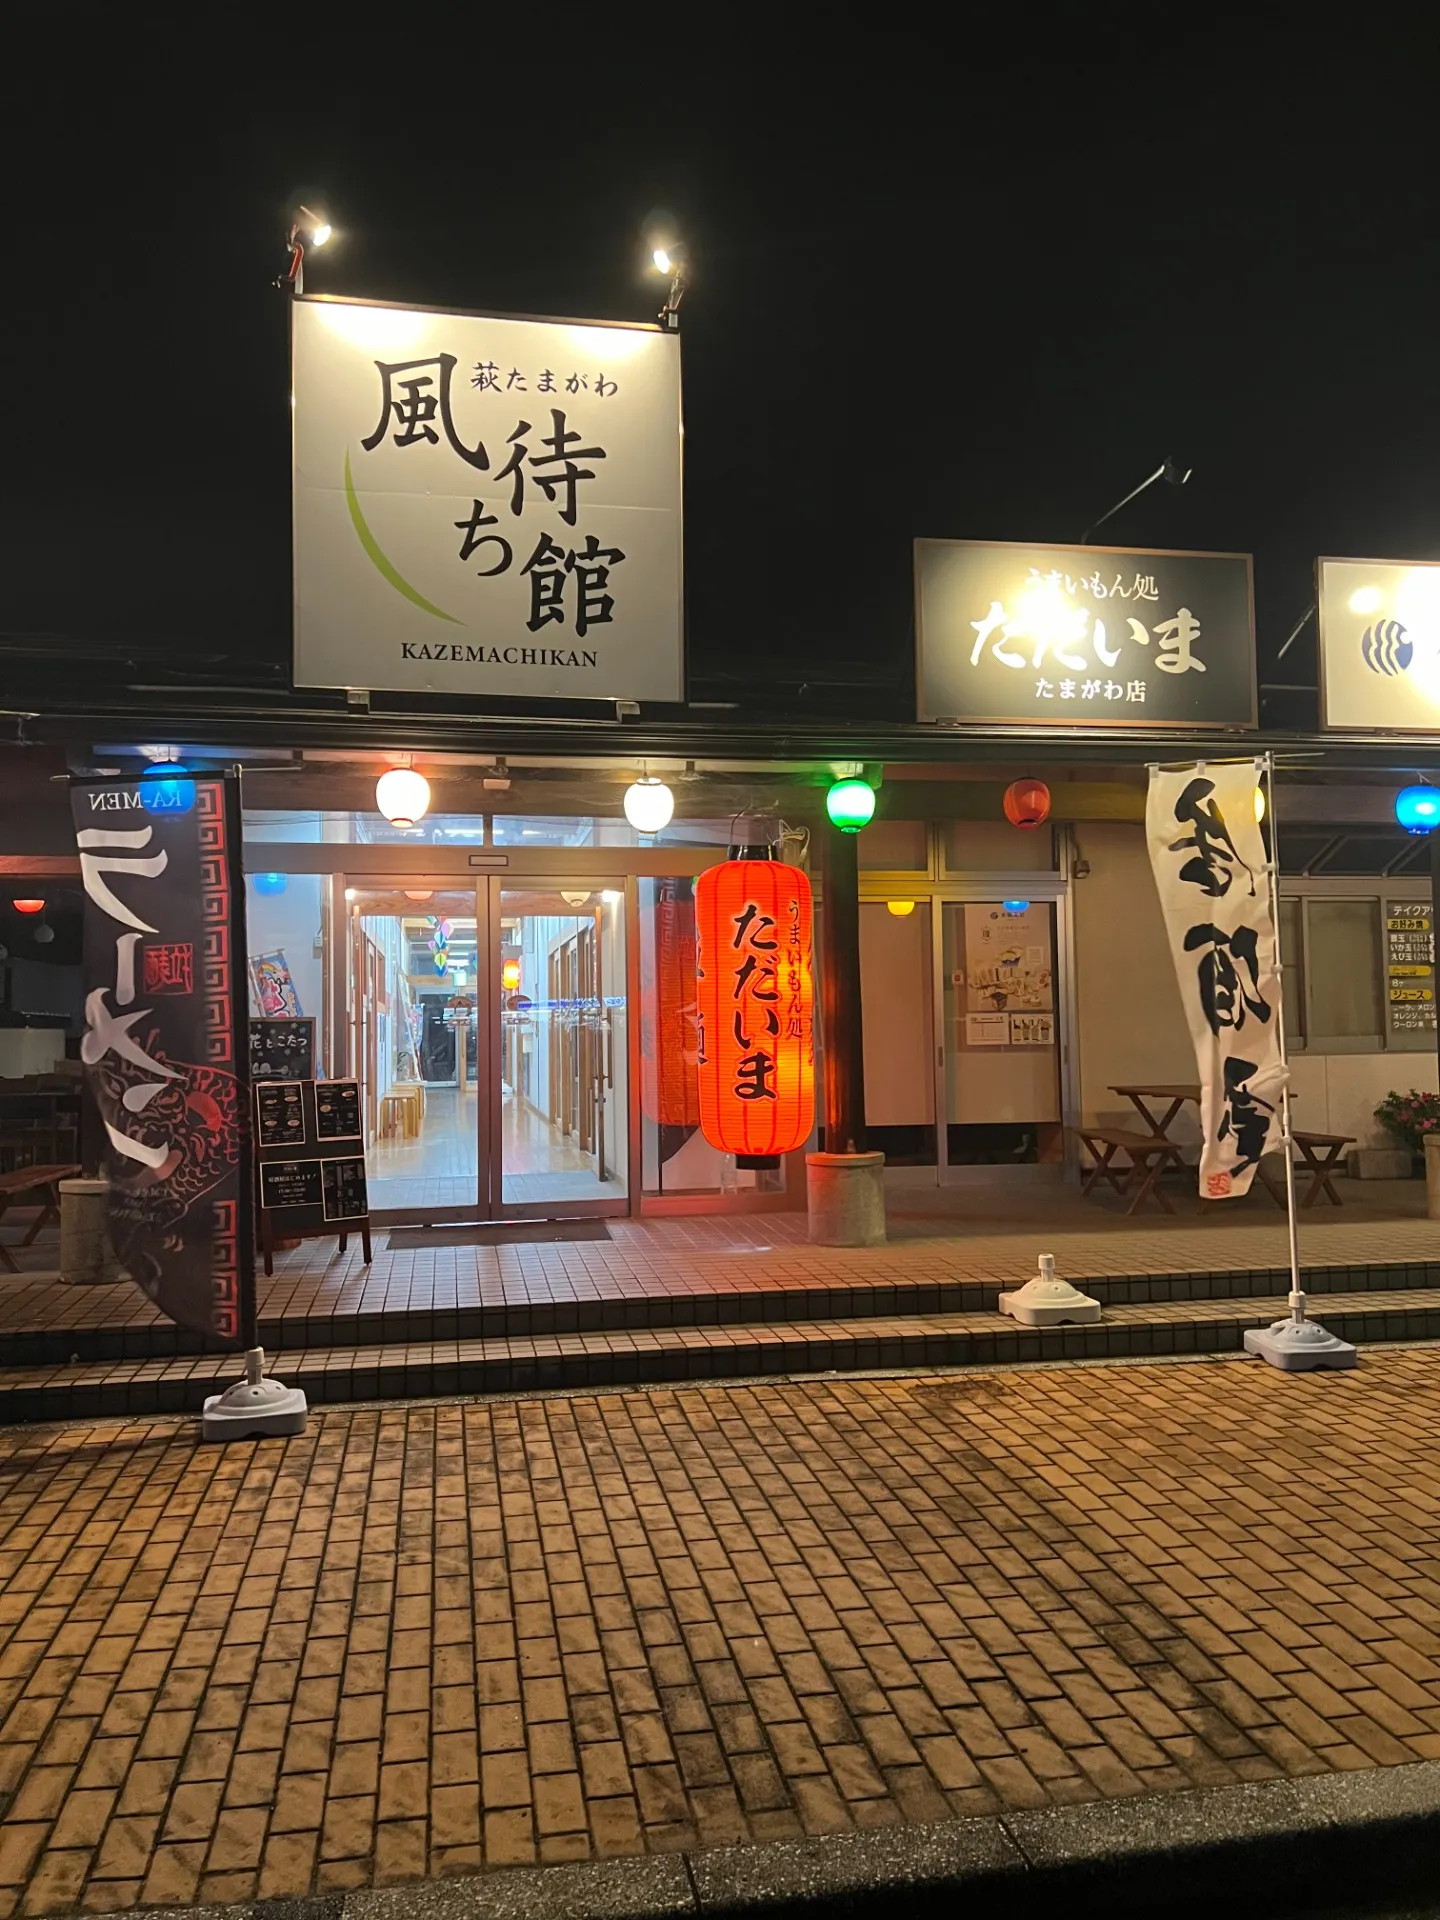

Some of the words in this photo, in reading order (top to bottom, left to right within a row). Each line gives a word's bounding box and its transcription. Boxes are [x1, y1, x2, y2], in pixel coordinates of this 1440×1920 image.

[470, 361, 619, 398] 萩たまがわ
[360, 352, 626, 638] 風待ち館
[1025, 567, 1160, 601] うまいもん処
[970, 600, 1207, 674] ただいま
[401, 642, 598, 668] KAZEMACHIKAN
[1035, 677, 1147, 703] たまがわ店
[1393, 905, 1434, 916] テイクア
[787, 900, 804, 1040] うまいもん処
[733, 904, 780, 1101] ただいま
[1393, 990, 1424, 1000] ジュース
